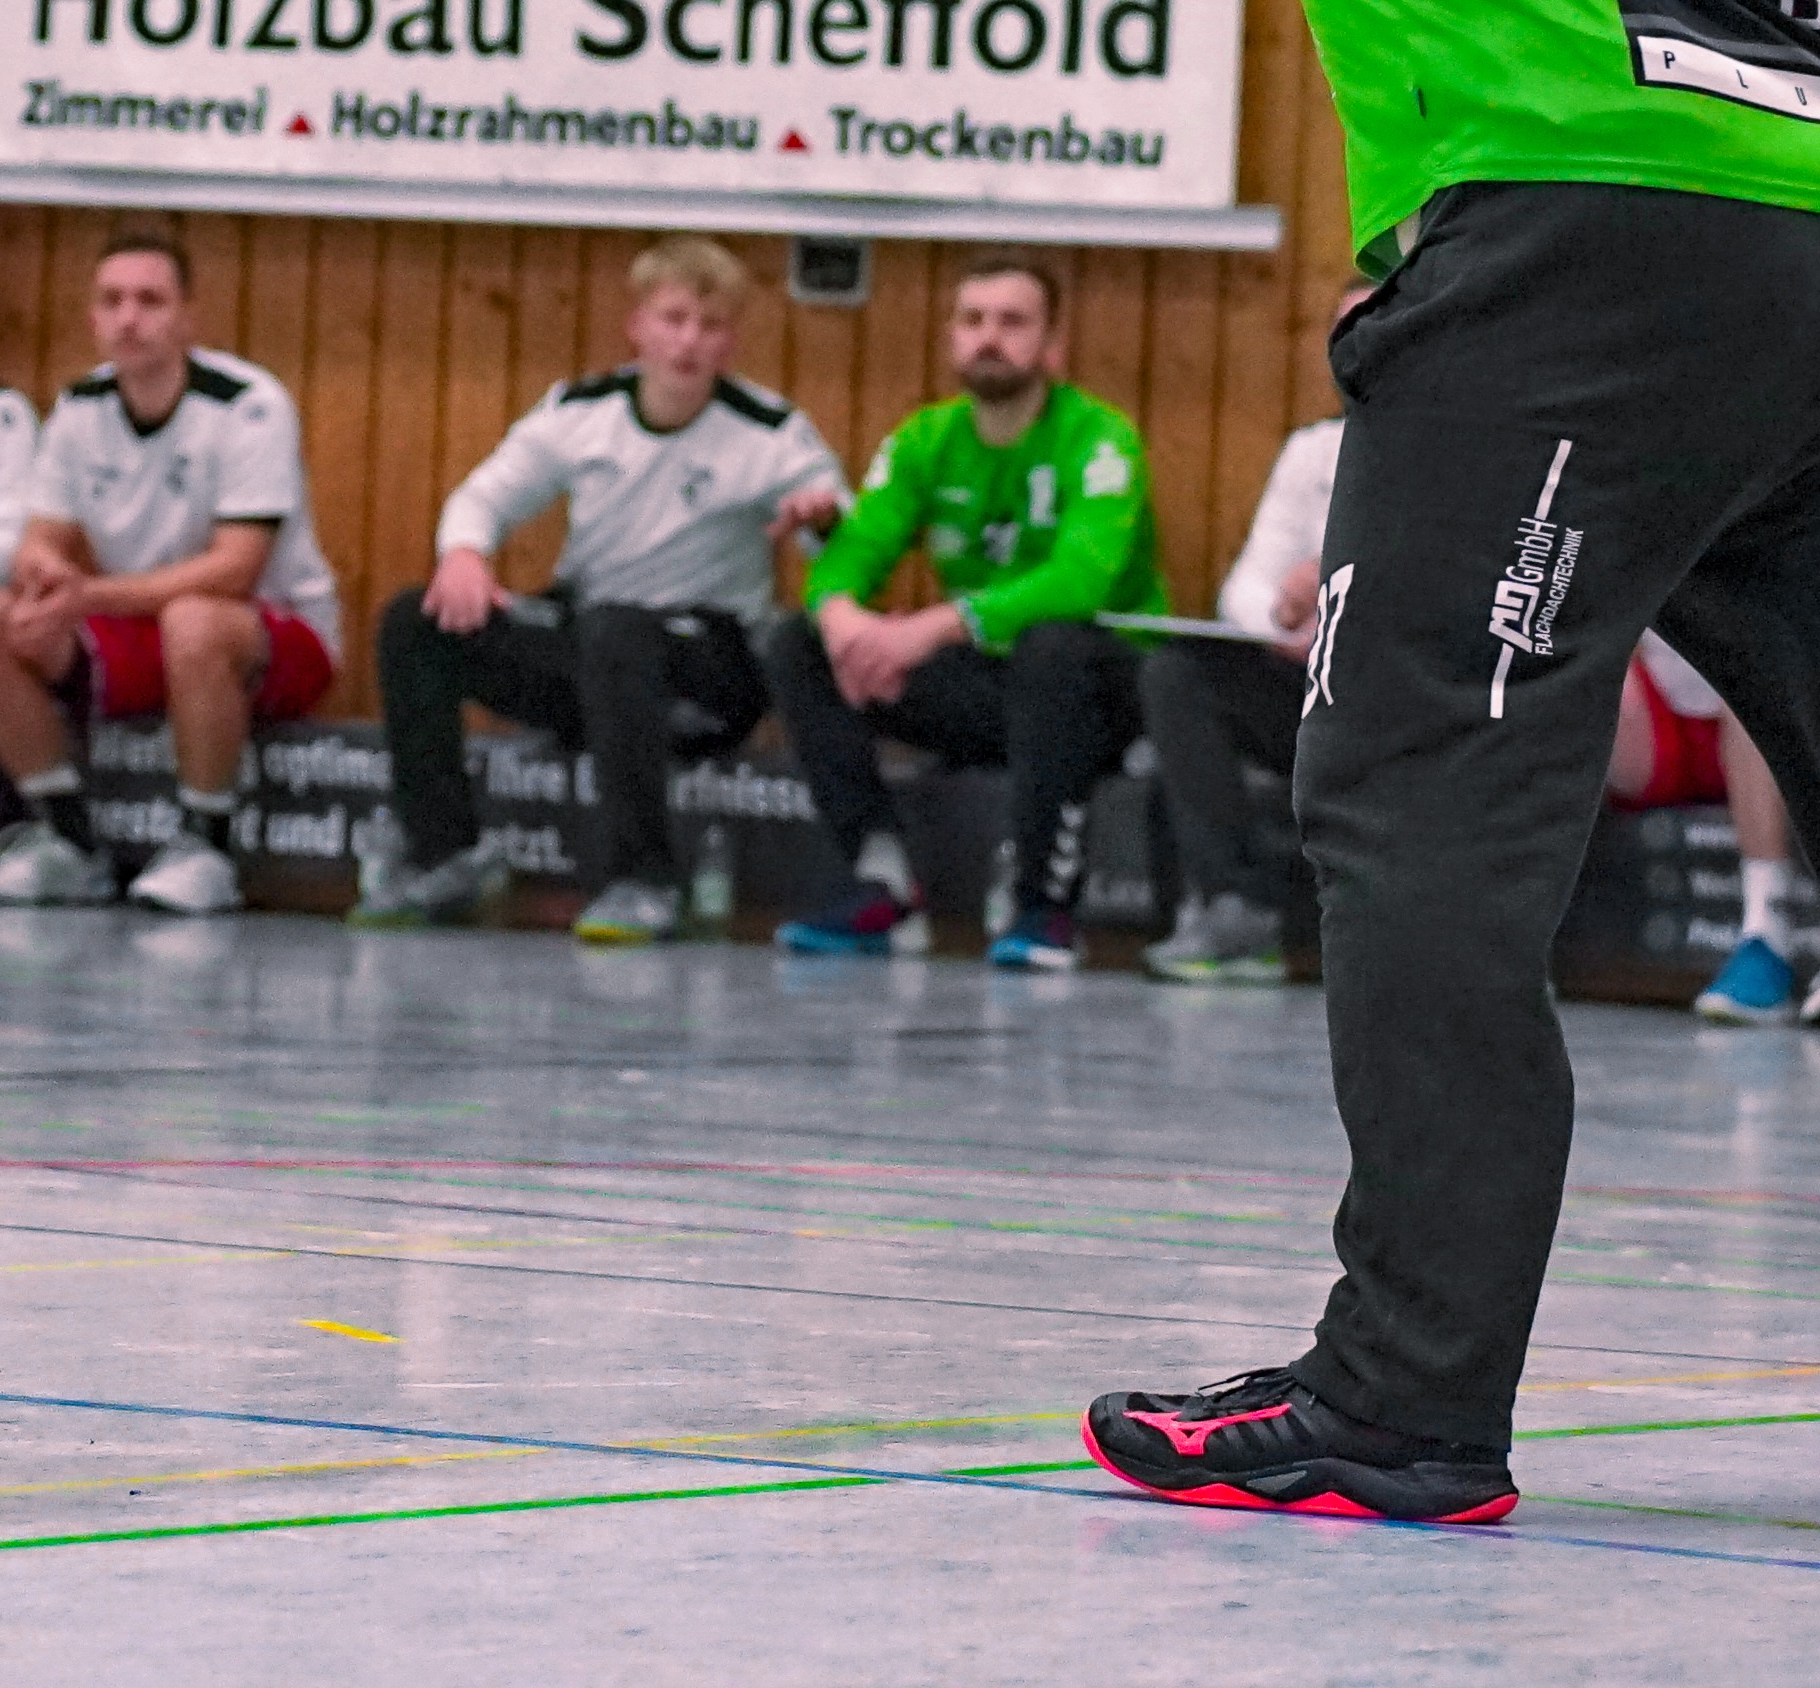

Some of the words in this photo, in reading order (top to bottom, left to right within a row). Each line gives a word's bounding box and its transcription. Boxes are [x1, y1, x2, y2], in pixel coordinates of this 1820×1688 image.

[19, 79, 270, 134] Zimmerei
[331, 89, 760, 152] Holzrahmenbau
[828, 107, 1165, 168] Trockenbau
[1506, 517, 1557, 583] GmbH
[1535, 527, 1584, 655] FLACHDACHTECHNIK
